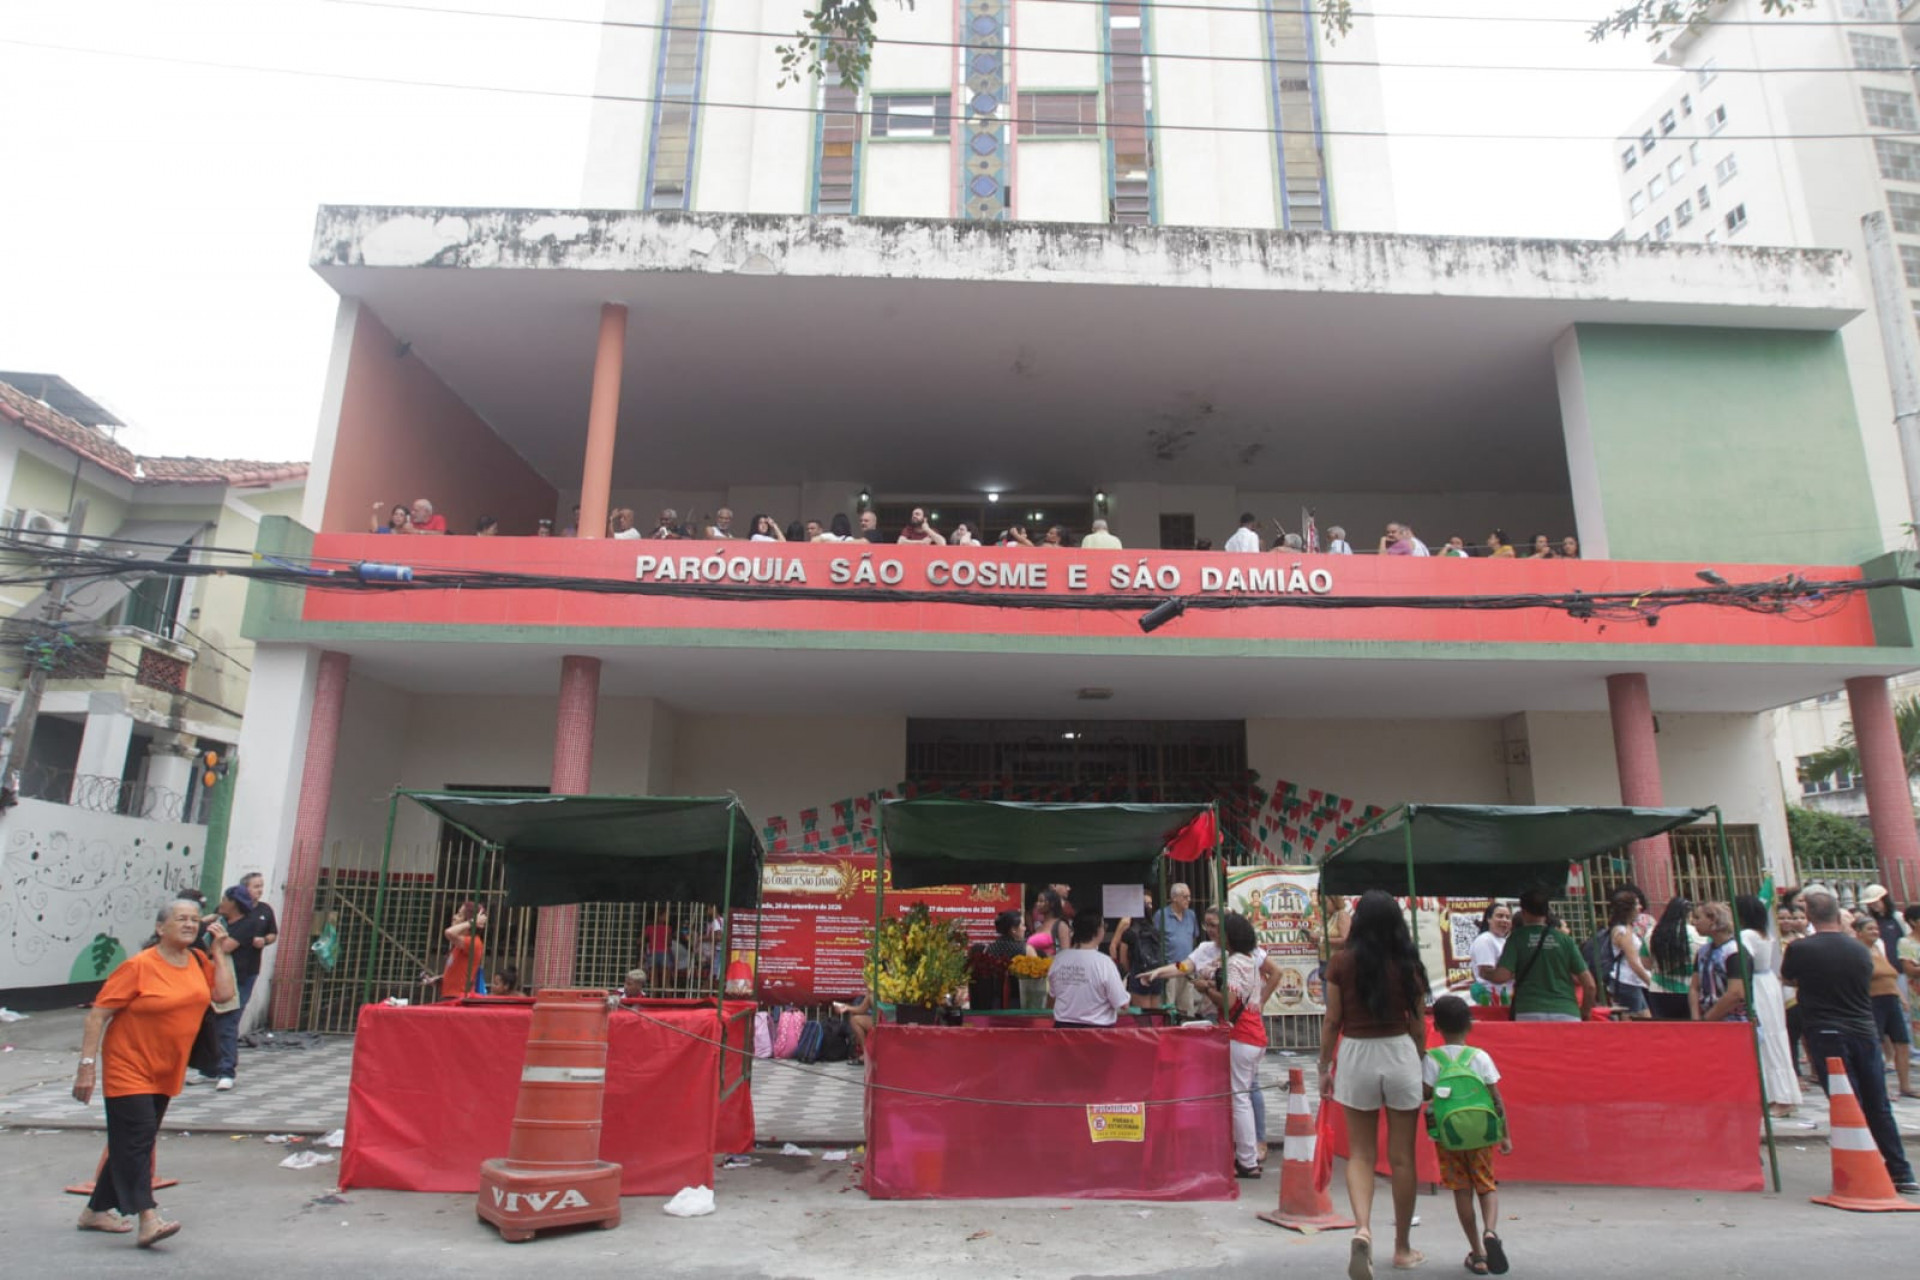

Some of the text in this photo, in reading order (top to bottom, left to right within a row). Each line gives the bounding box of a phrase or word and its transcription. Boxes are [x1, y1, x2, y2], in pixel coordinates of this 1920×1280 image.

[635, 548, 1333, 594] PARÓQUIA SÃO COSME E SÃO DAMIÃO
[1267, 921, 1309, 929] RUMO AO
[491, 1186, 590, 1212] VIVA
